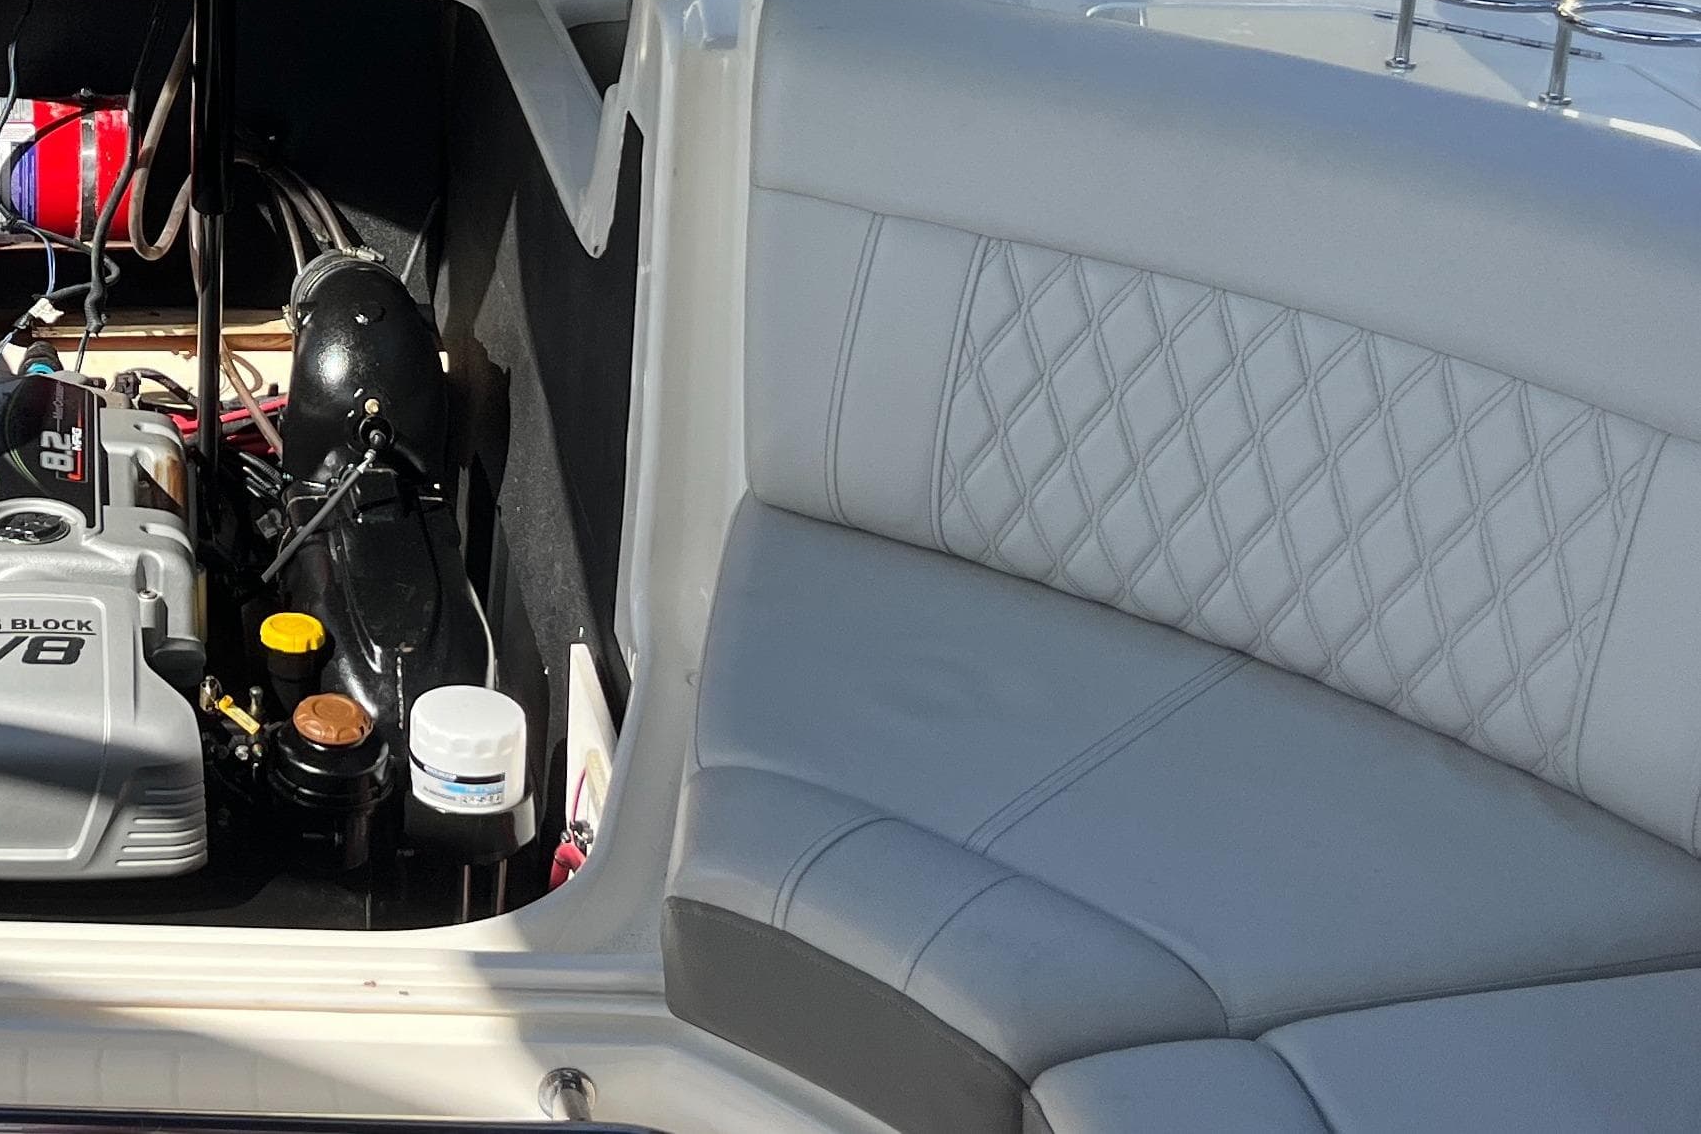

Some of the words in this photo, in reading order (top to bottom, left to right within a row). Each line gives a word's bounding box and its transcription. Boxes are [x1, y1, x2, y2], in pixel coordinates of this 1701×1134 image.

[40, 430, 75, 472] 8.2
[71, 426, 83, 452] MAG
[10, 617, 93, 632] BLOCK
